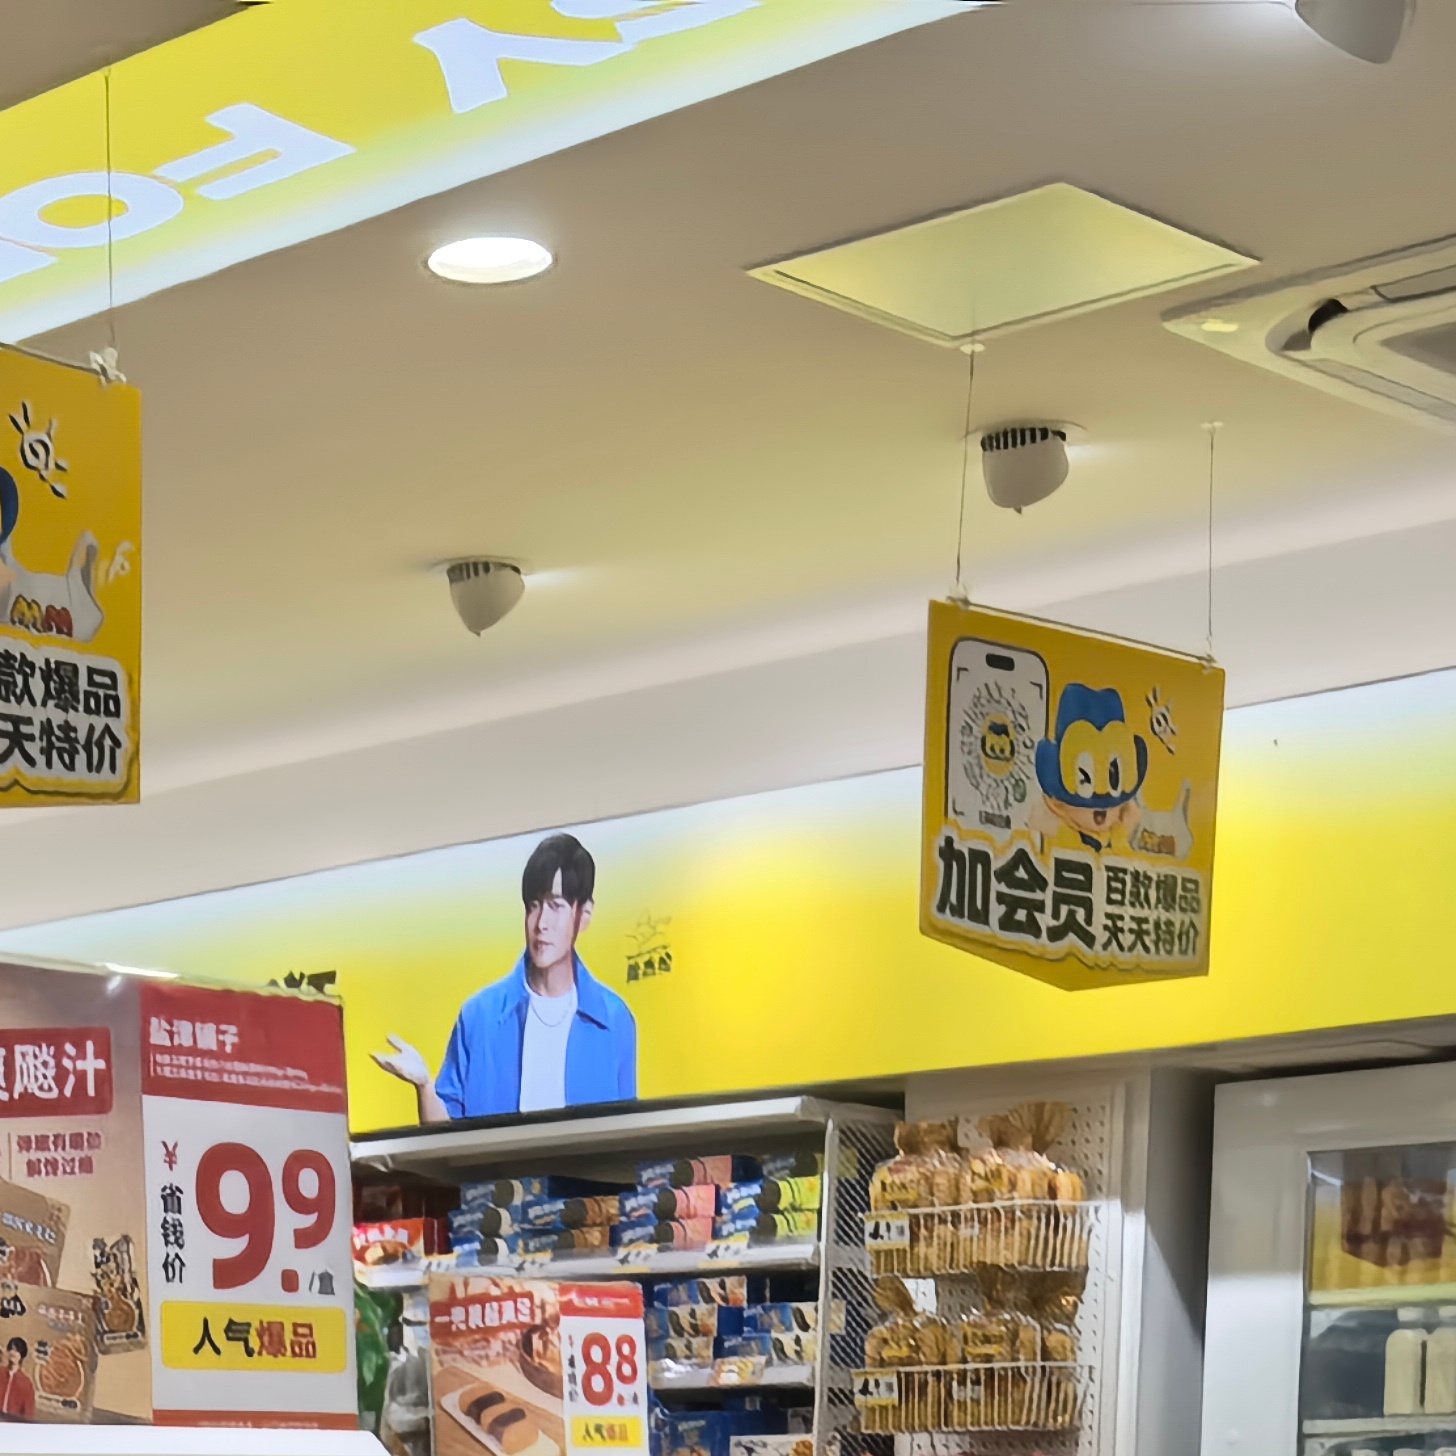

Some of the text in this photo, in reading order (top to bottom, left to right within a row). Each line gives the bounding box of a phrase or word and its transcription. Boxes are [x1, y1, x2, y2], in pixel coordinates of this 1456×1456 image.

[936, 836, 1096, 950] 加会员
[193, 1316, 317, 1358] 人气爆品
